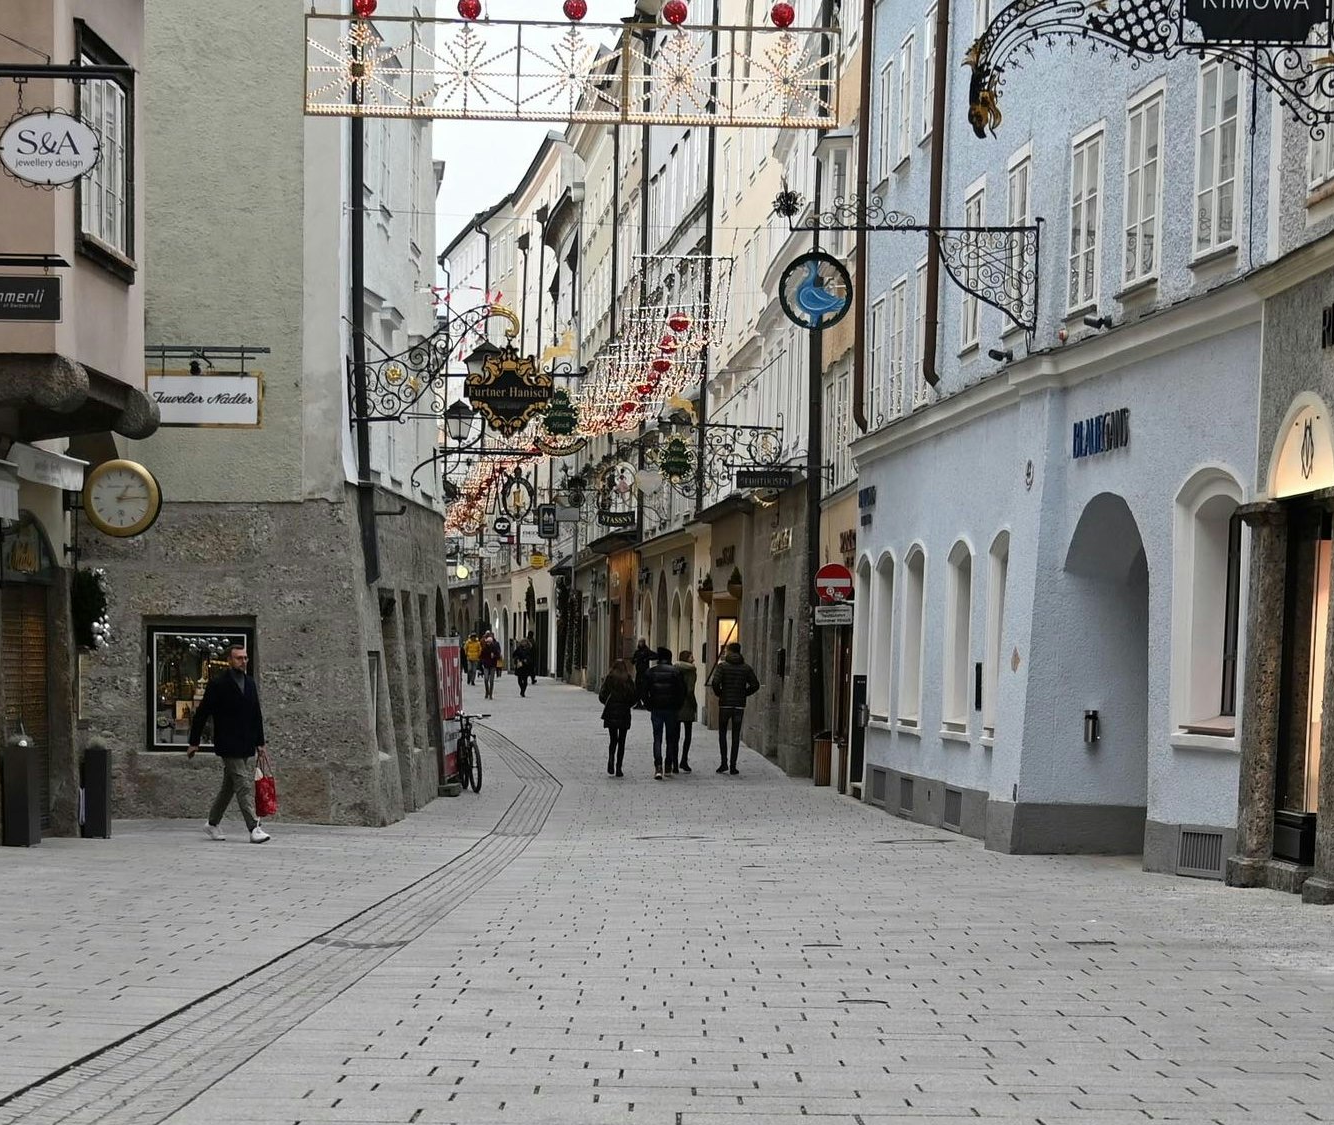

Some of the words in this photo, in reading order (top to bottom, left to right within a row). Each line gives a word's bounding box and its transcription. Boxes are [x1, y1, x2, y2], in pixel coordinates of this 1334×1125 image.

[17, 129, 80, 156] S&A
[15, 158, 53, 168] jewellery
[55, 157, 83, 168] design
[153, 391, 204, 404] Juwelier
[468, 386, 506, 398] Furtner
[509, 386, 549, 398] Hanisch
